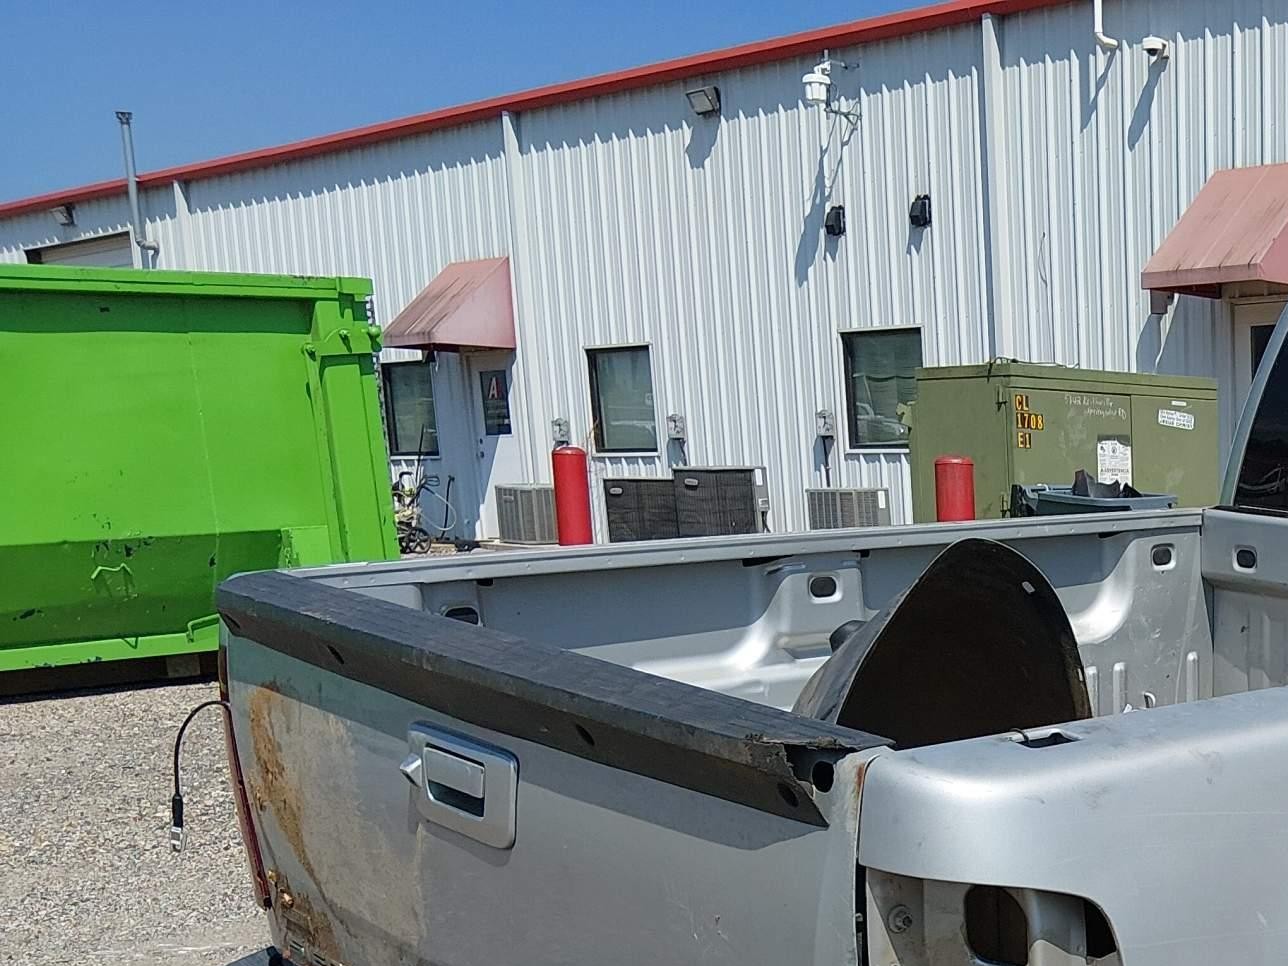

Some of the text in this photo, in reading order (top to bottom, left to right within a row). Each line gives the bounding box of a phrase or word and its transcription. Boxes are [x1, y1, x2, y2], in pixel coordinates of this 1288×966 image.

[1015, 395, 1029, 410] CL
[1017, 413, 1043, 430] 1708
[1018, 432, 1031, 448] E1
